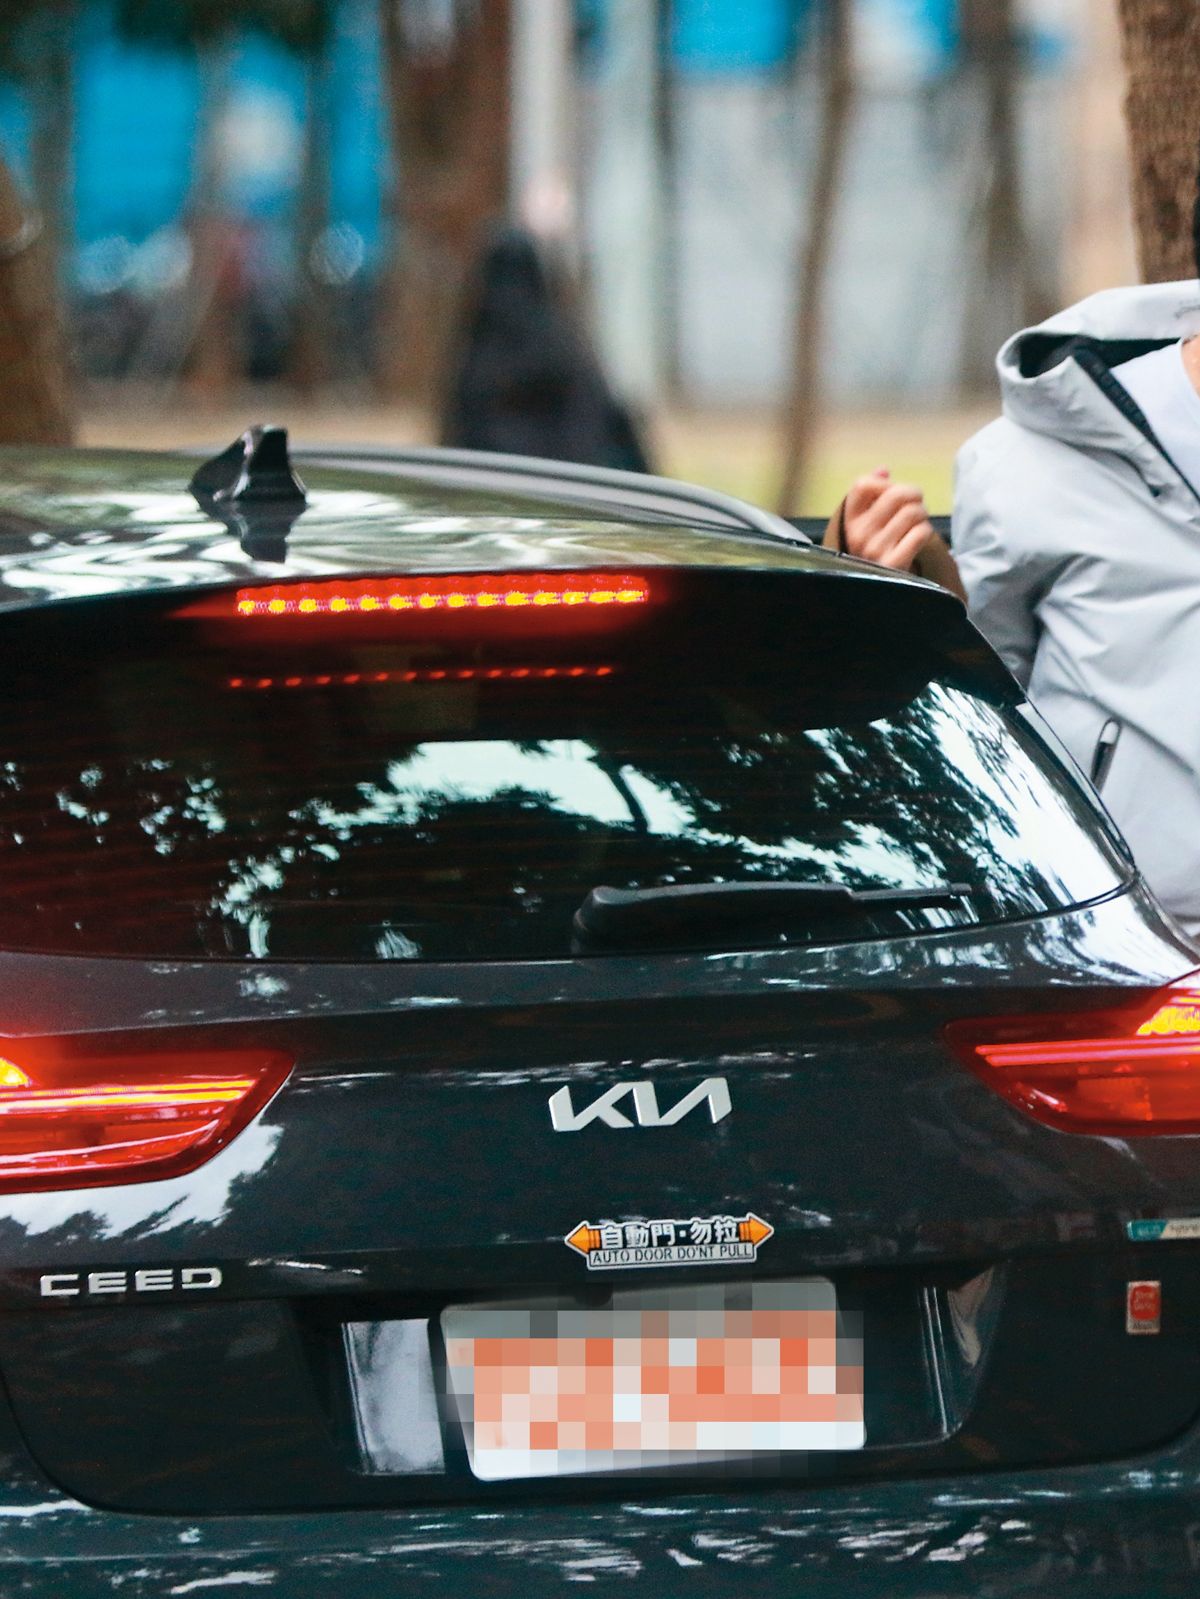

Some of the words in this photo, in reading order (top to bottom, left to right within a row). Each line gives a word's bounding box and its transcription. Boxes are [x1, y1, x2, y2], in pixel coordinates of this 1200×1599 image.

[549, 1077, 732, 1132] KIA
[593, 1250, 630, 1264] AUTO
[635, 1248, 673, 1262] DOOR
[720, 1244, 752, 1257] PULL
[40, 1267, 223, 1297] CEED
